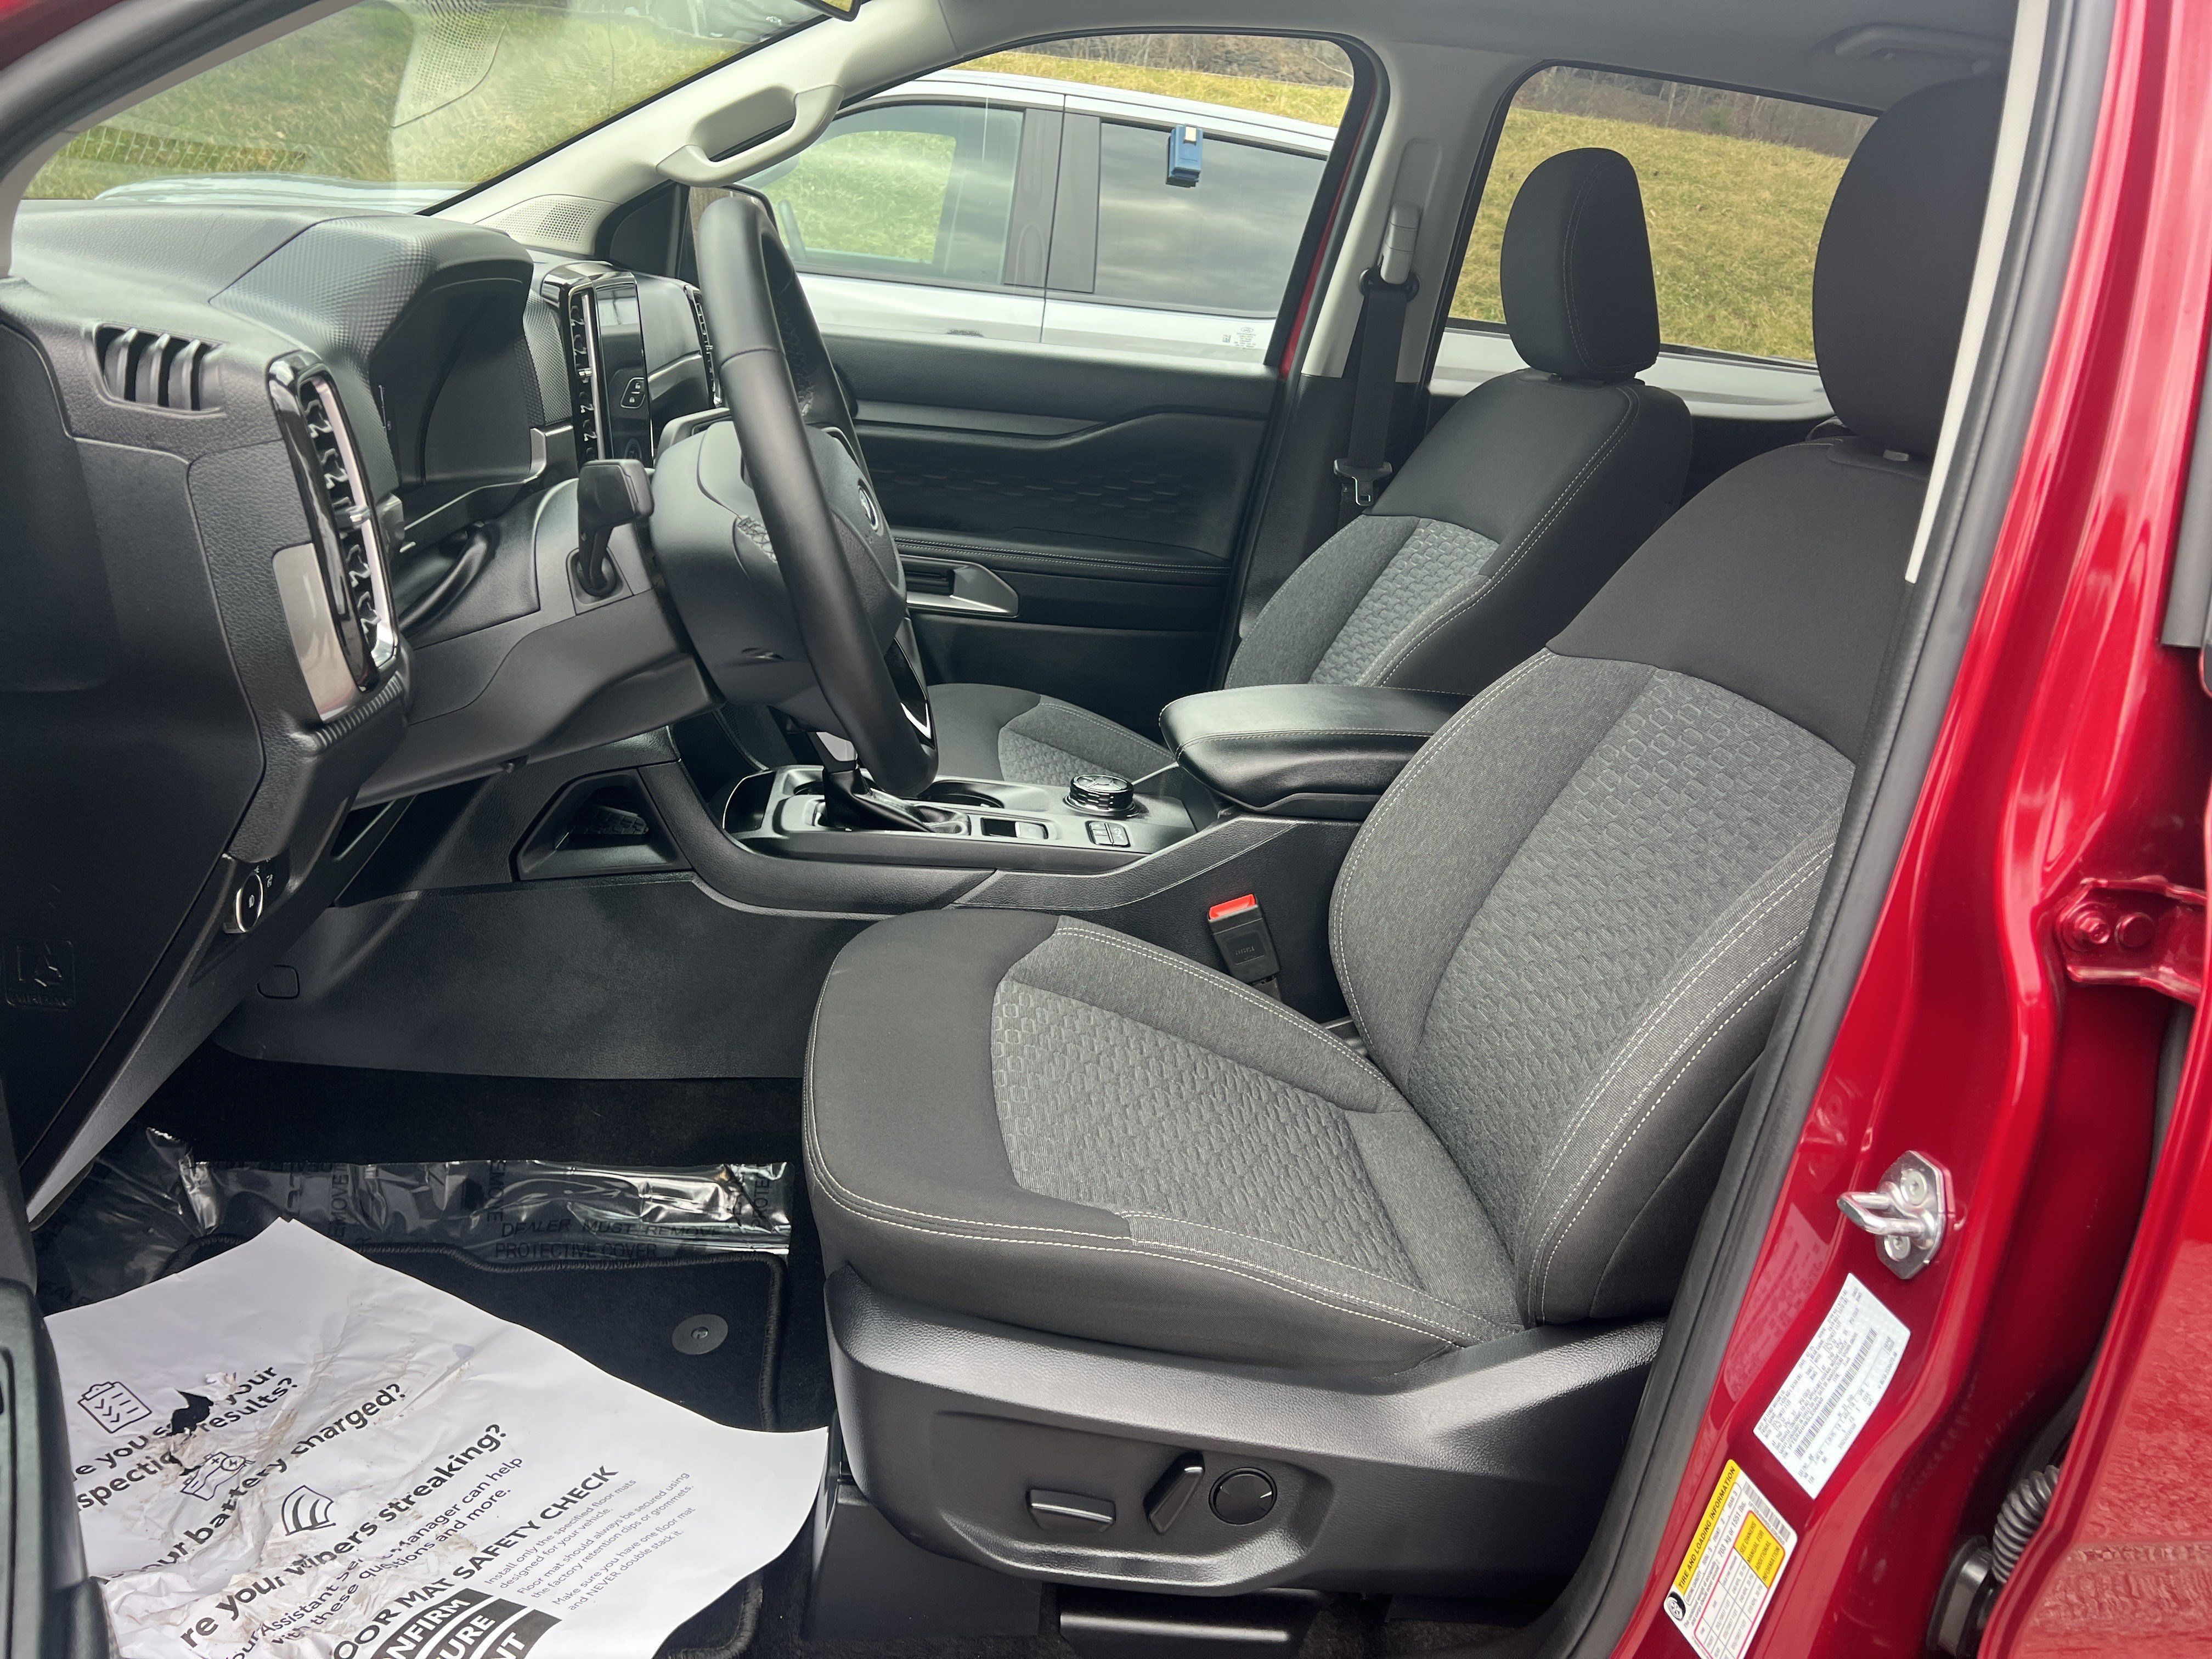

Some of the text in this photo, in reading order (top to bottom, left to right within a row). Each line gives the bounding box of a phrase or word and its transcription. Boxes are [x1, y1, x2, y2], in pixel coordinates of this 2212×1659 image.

[494, 1242, 658, 1259] PROTECTIVE COVER
[501, 1218, 571, 1237] DEALER
[582, 1220, 633, 1235] MUST
[195, 1377, 298, 1432] results?
[224, 1366, 278, 1406] your
[291, 1383, 407, 1455] charged?
[94, 1435, 149, 1470] you
[215, 1571, 286, 1622] your
[376, 1424, 507, 1522] streaking?
[394, 1578, 455, 1609] MAT
[452, 1520, 542, 1580] SAFETY
[539, 1465, 619, 1520] CHECK
[483, 1479, 637, 1584] Install only the specified floor mats
[516, 1472, 690, 1594] Floor mat should always be secured using
[531, 1588, 551, 1598] the
[547, 1562, 584, 1588] factory
[582, 1533, 623, 1563] retention
[621, 1521, 642, 1533] clips
[651, 1486, 694, 1516] grommets.
[1678, 1465, 1735, 1589] TIRE AND LOADING INFORMATION
[1723, 1533, 1731, 1545] kg
[1728, 1526, 1734, 1536] or
[1730, 1510, 1741, 1528] 1551
[1739, 1520, 1756, 1555] SEE OWNERS
[1746, 1528, 1764, 1564] MANUAL FOR
[259, 1584, 340, 1636] Assistant
[461, 1481, 490, 1504] can
[484, 1458, 523, 1481] help
[311, 1584, 360, 1628] these
[359, 1541, 436, 1579] questions
[435, 1519, 468, 1542] and
[466, 1489, 511, 1521] more.
[500, 1509, 613, 1588] designed for your vehicle.
[551, 1507, 696, 1605] Make sure you have one floor mat
[568, 1596, 589, 1611] and
[585, 1571, 622, 1596] NEVER
[619, 1548, 652, 1571] double
[650, 1535, 675, 1550] stack
[1717, 1542, 1726, 1558] 703
[1754, 1538, 1771, 1572] ADDITIONAL
[1761, 1545, 1780, 1582] INFORMATION
